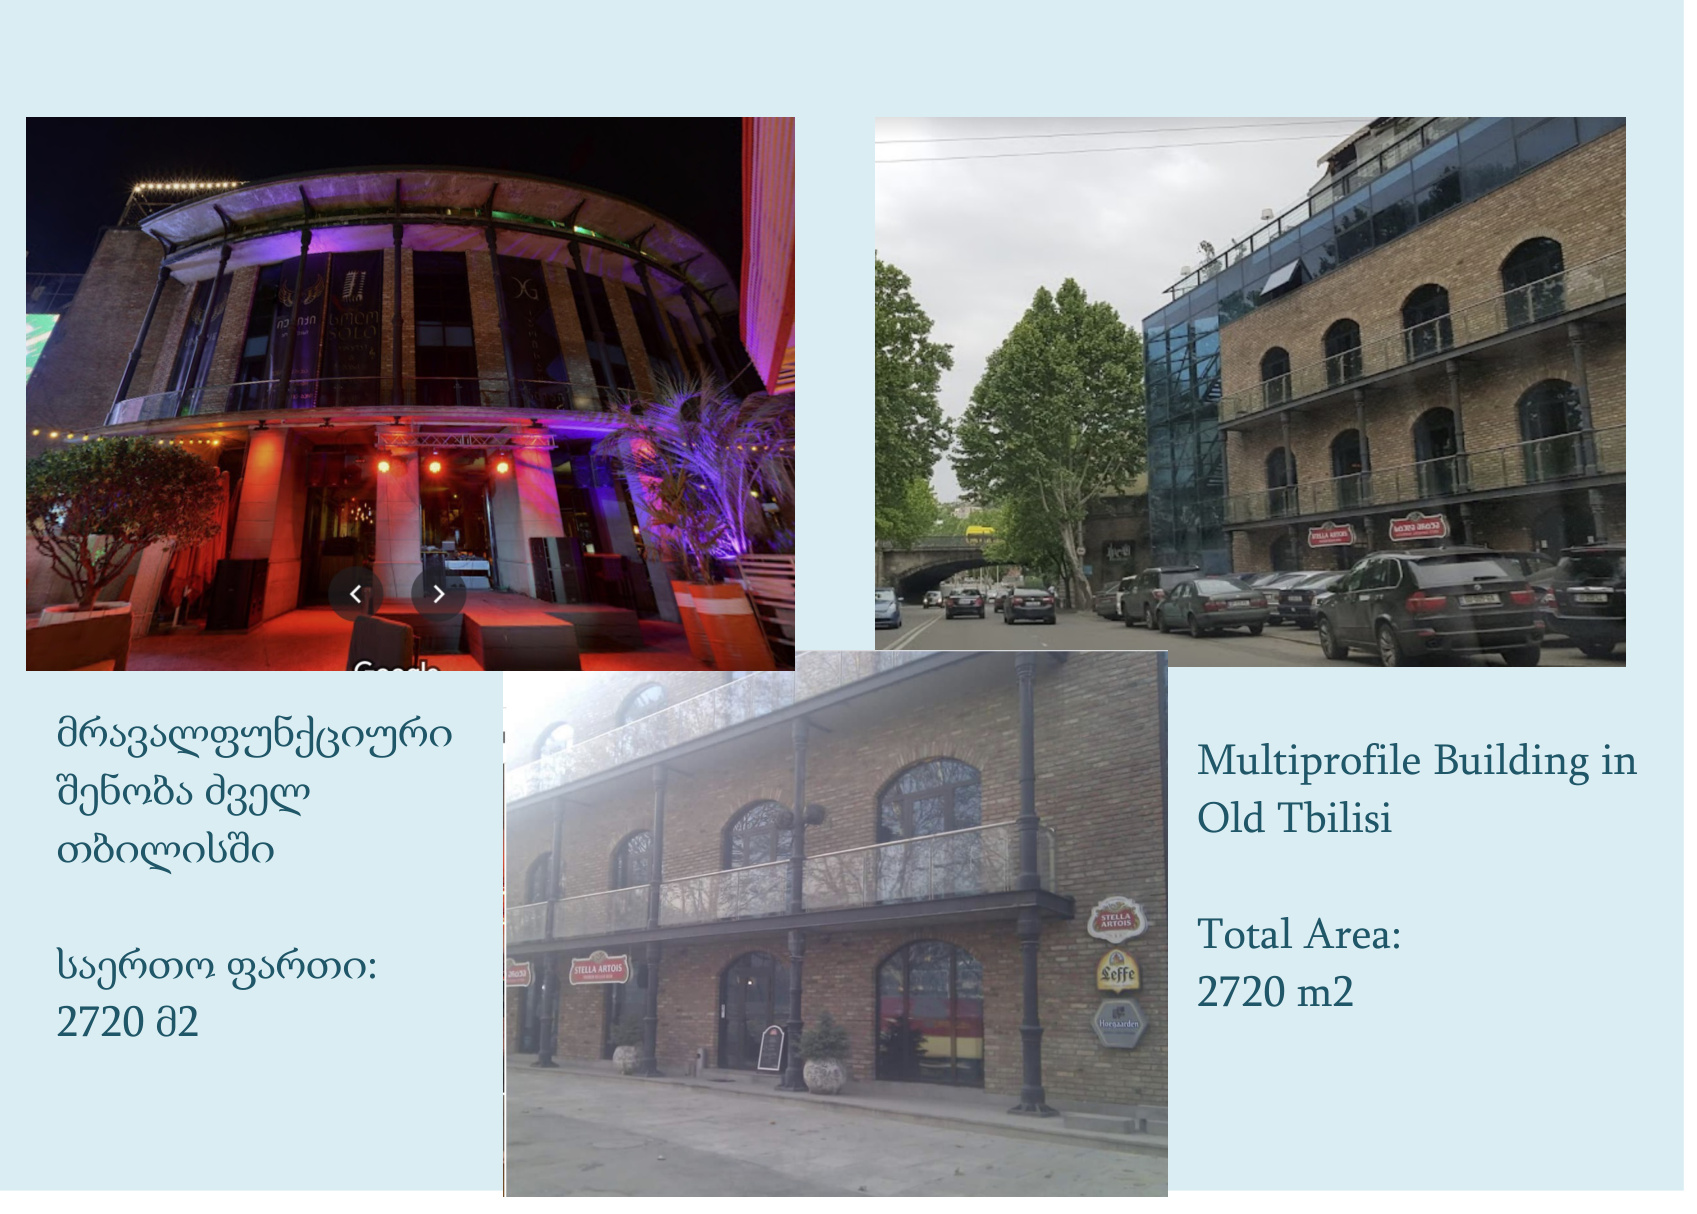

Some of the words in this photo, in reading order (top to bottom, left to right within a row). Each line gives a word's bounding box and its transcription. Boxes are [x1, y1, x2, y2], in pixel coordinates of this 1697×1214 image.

[328, 325, 377, 341] SOLO
[1100, 920, 1132, 928] ARTOIS
[574, 966, 596, 974] STELLA
[598, 964, 622, 973] ARTOIS
[1101, 966, 1135, 983] Leffe
[1099, 1019, 1139, 1029] Hoegaarden
